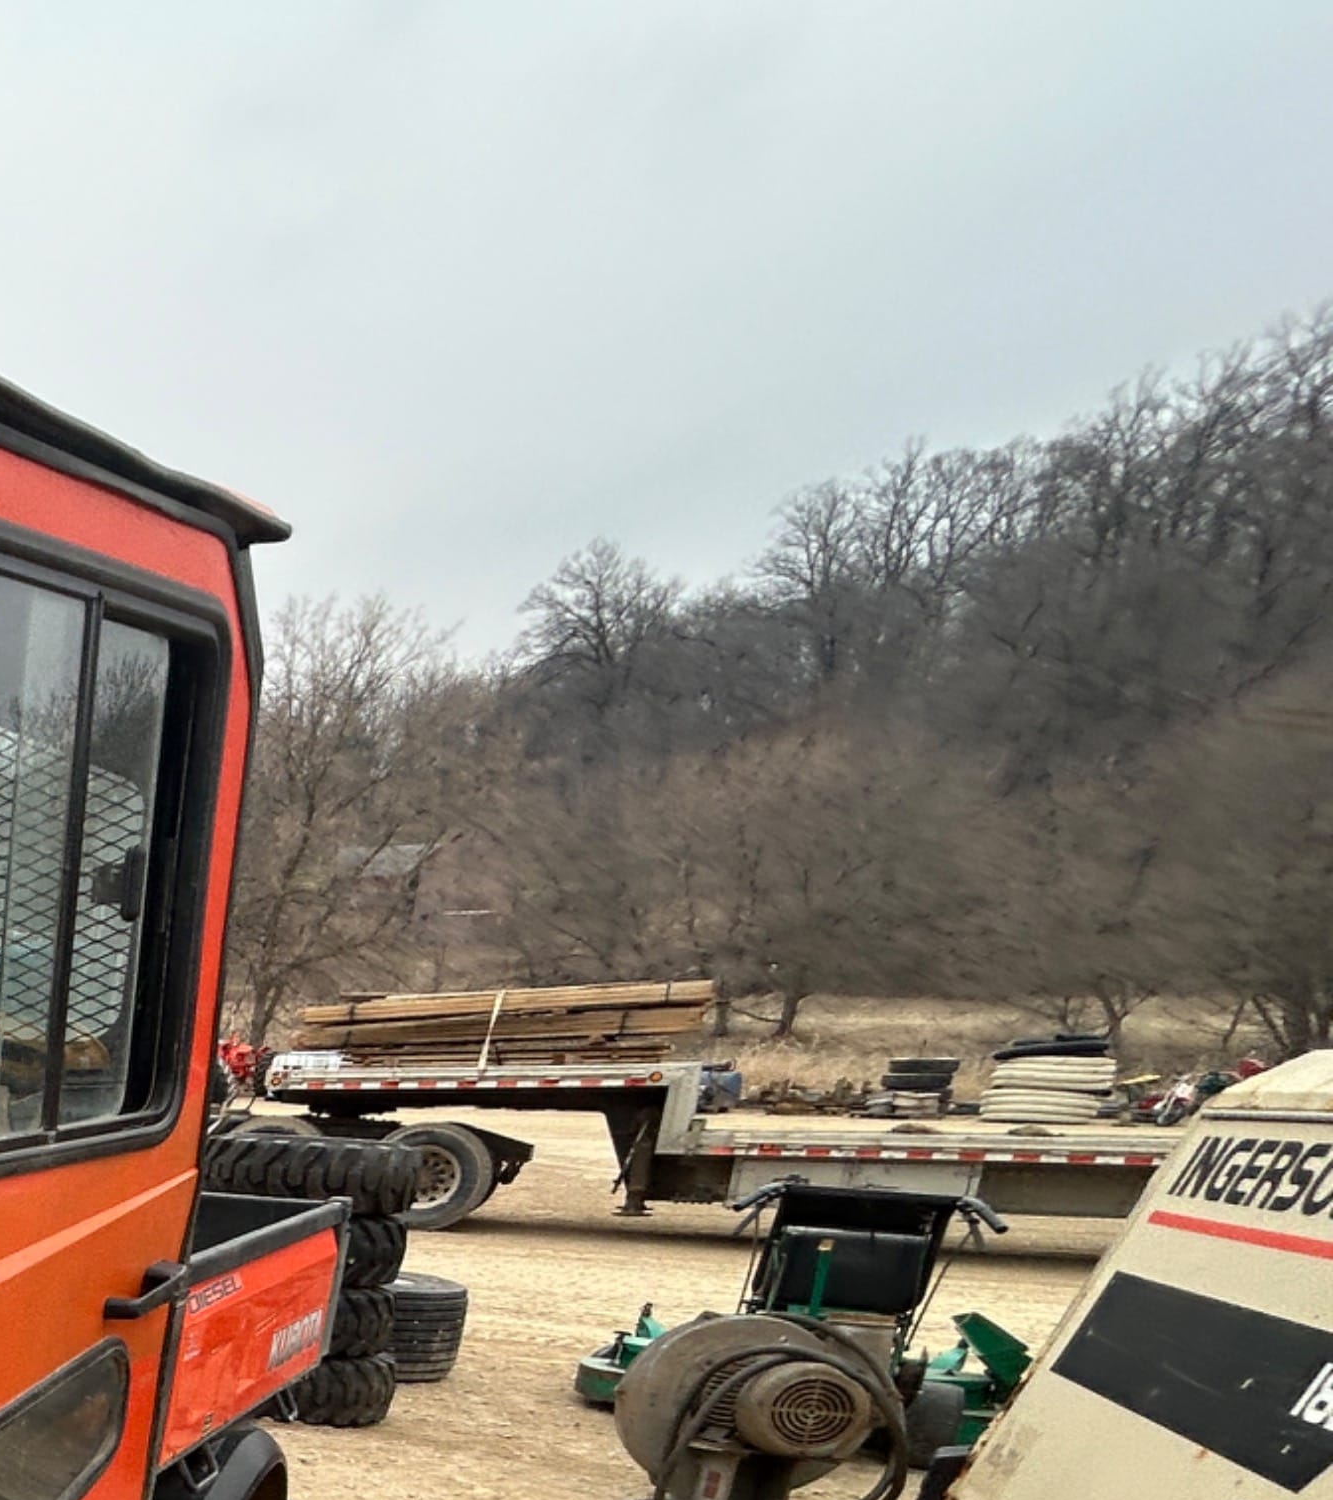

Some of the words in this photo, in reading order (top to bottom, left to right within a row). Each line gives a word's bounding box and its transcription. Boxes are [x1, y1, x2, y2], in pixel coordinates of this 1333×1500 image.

[1167, 1136, 1333, 1219] INGERSO
[188, 1274, 242, 1314] DIESEL
[1289, 1361, 1333, 1432] 18
